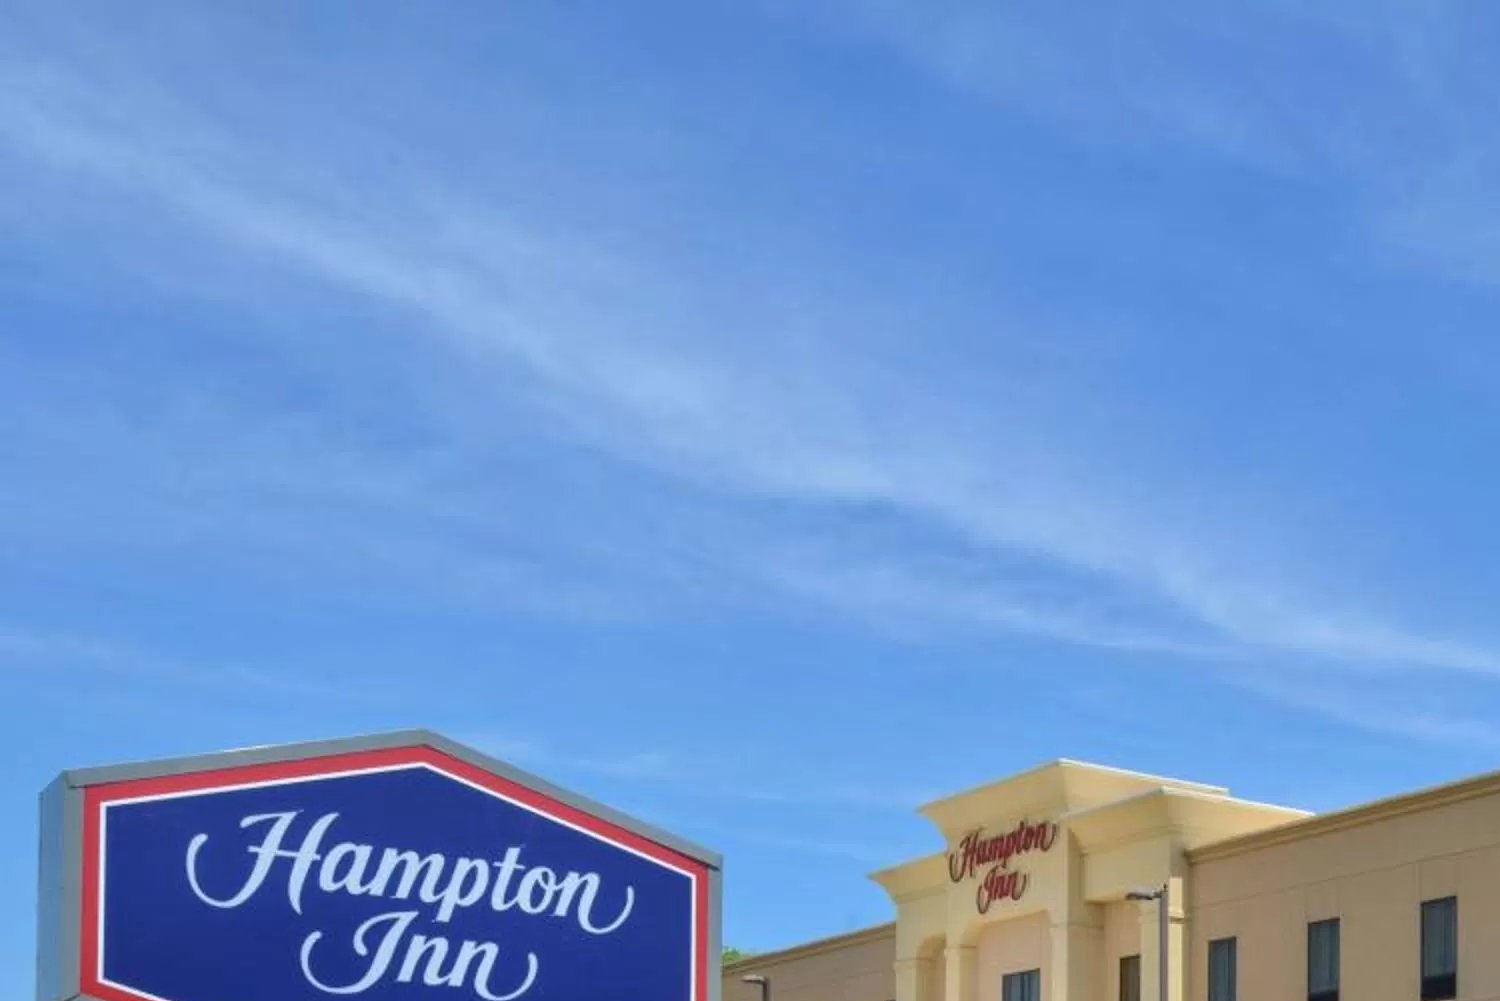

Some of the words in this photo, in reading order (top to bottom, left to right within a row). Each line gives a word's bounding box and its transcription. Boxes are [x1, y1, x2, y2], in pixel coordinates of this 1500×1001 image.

[186, 810, 635, 934] Hampton
[949, 821, 1057, 883] Hampton
[977, 865, 1027, 914] Inn
[301, 911, 538, 1001] Inn
